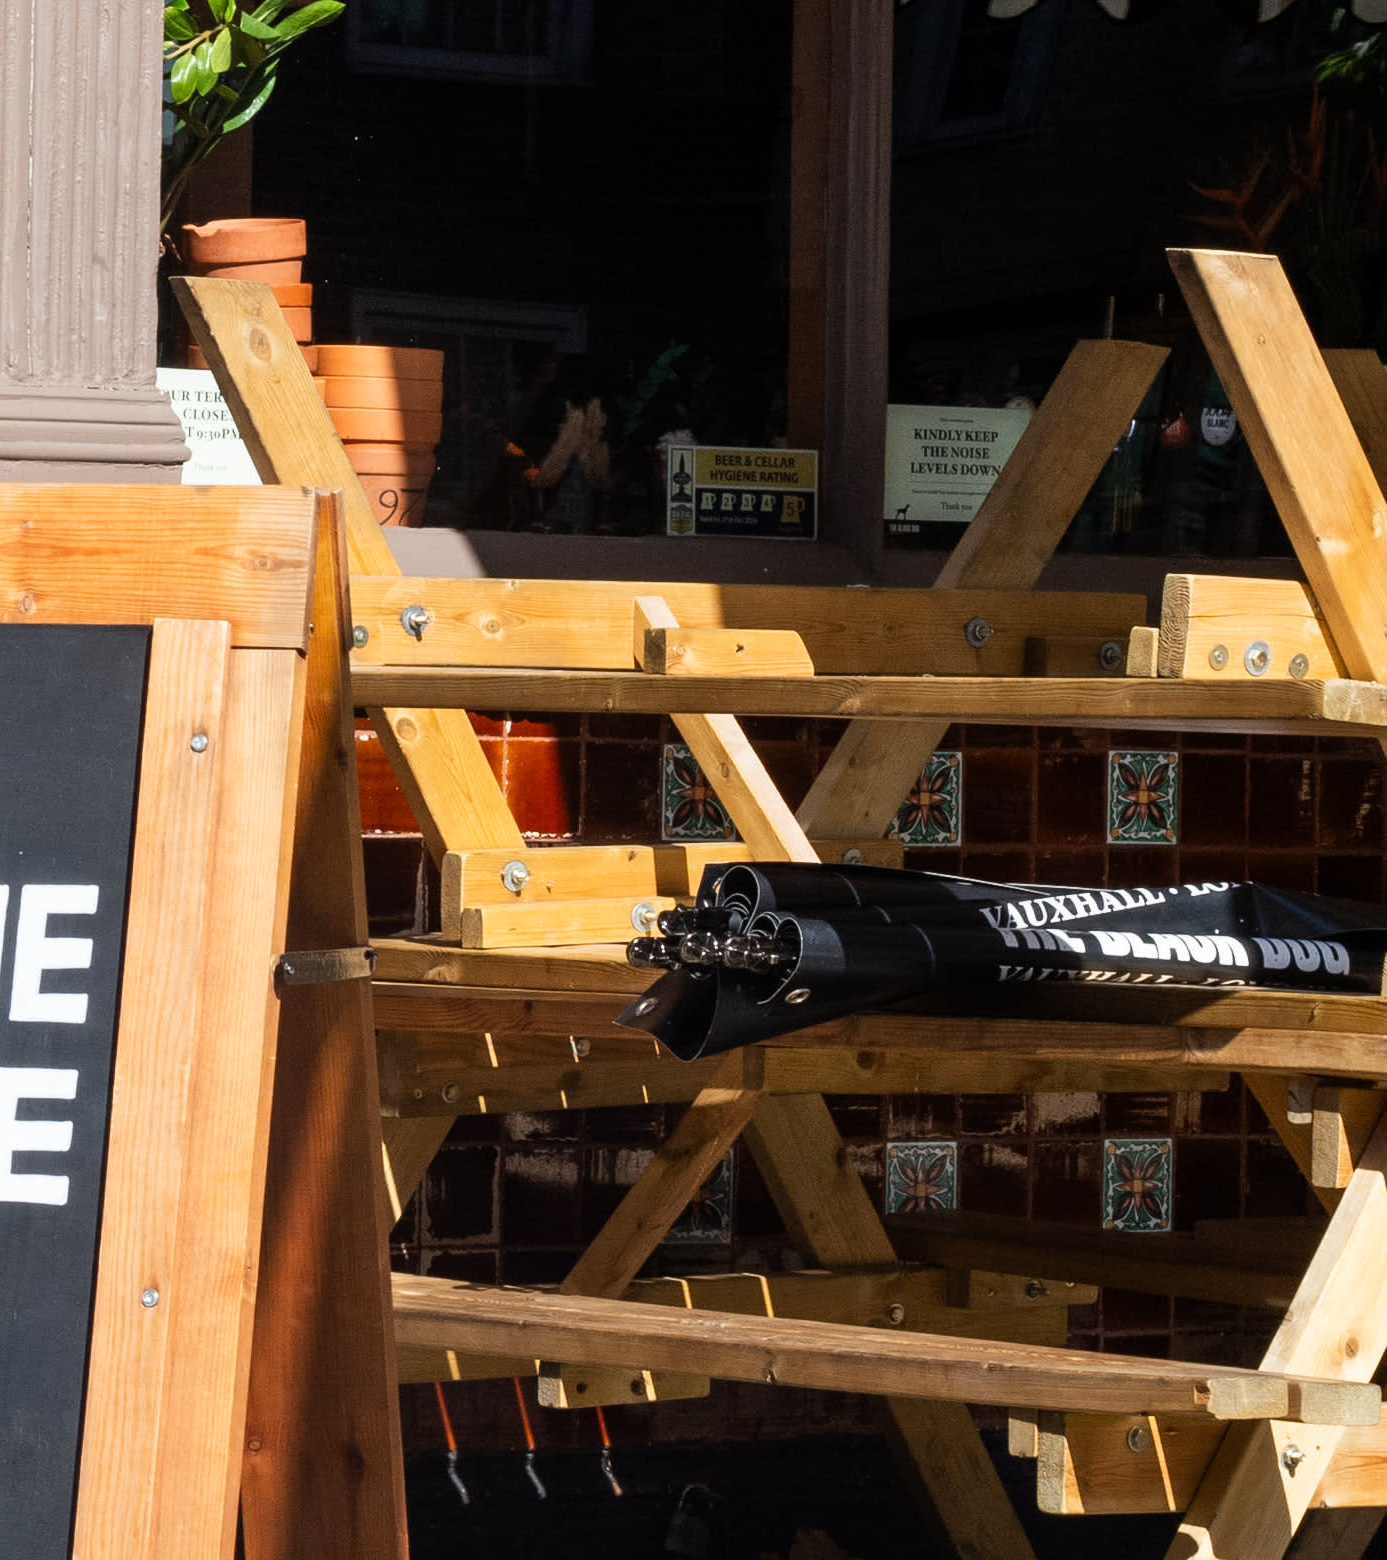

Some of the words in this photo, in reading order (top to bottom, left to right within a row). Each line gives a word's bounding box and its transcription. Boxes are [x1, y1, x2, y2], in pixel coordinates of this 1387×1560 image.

[171, 389, 190, 401] UR
[194, 391, 223, 403] TER
[183, 407, 230, 421] CLOSE
[913, 428, 964, 441] KINDLY
[965, 431, 999, 443] KEEP
[921, 445, 949, 458] THE
[950, 447, 991, 459] NOISE
[714, 454, 742, 467] BEER
[744, 455, 753, 467] &
[754, 456, 796, 469] CELLAR
[910, 462, 958, 475] LEVELS
[960, 463, 1001, 476] DOWN
[710, 470, 757, 483] HYGIENE
[759, 471, 799, 484] RATING
[786, 502, 795, 518] 5
[940, 501, 961, 511] Thank
[979, 887, 1166, 929] VAUXHALL
